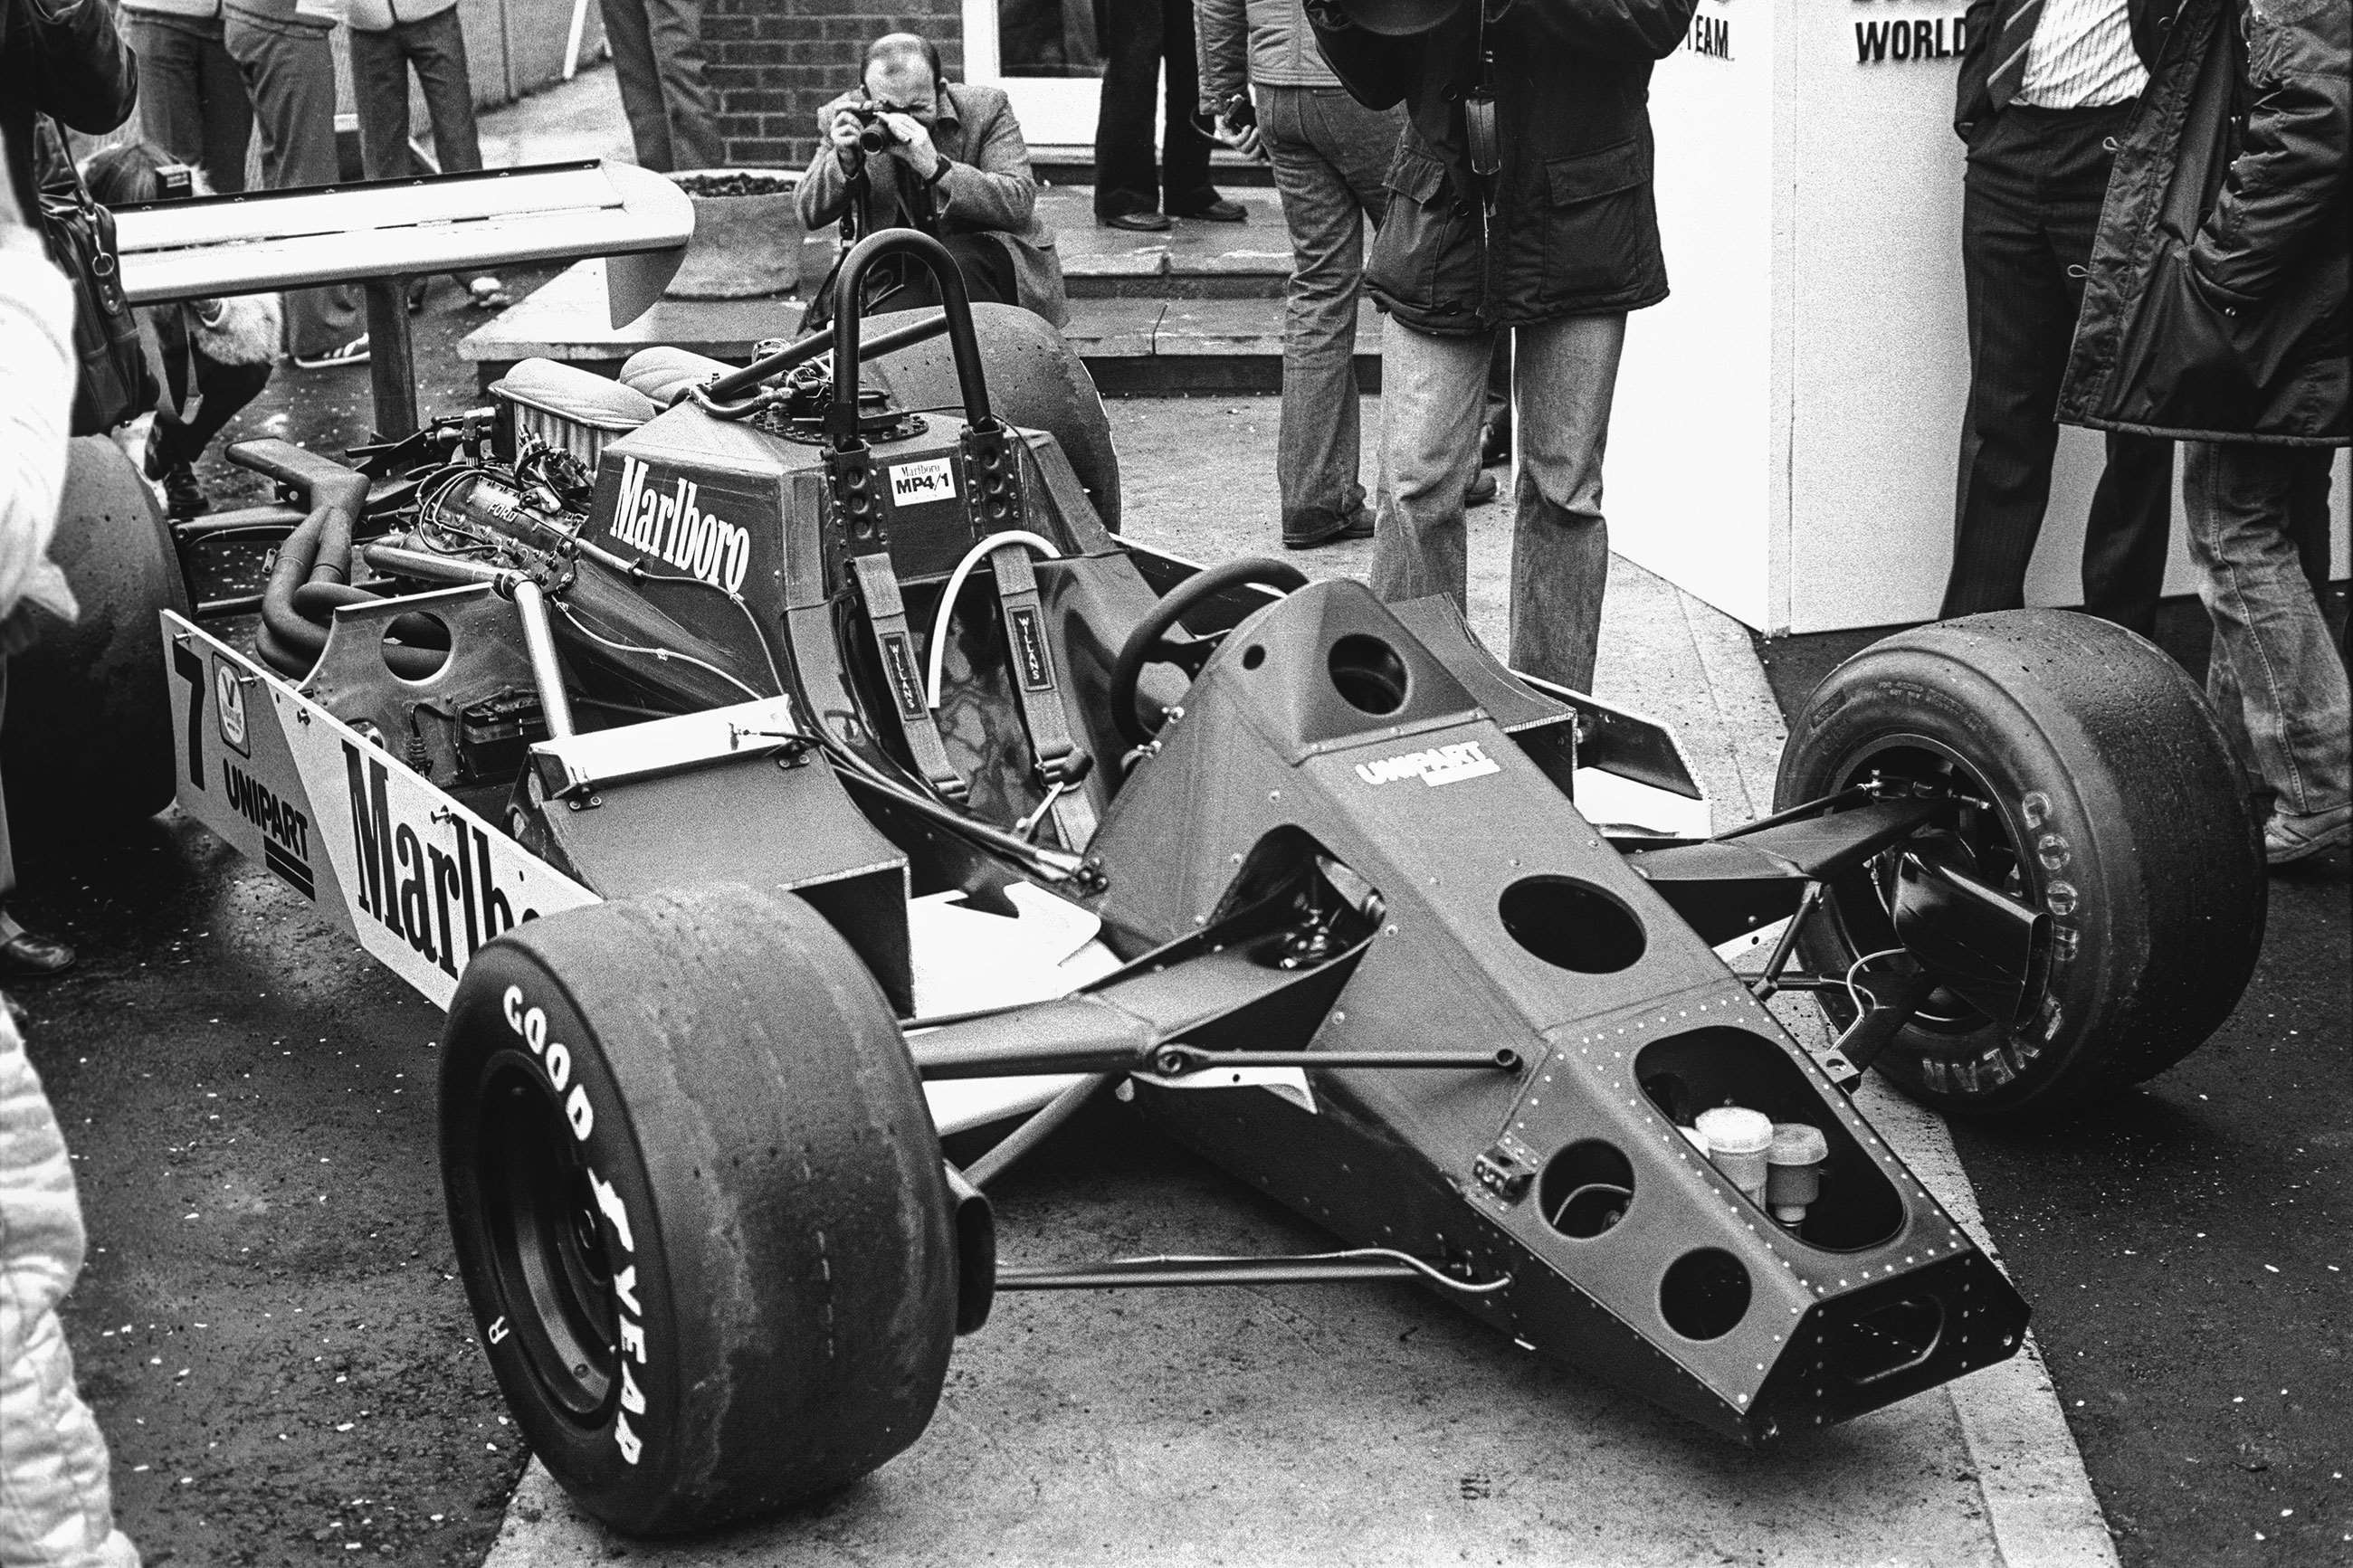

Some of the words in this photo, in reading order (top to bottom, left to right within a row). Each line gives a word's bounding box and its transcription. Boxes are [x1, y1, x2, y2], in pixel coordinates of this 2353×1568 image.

[1855, 17, 1967, 61] WORLD
[487, 500, 519, 523] FORD
[896, 472, 949, 495] MP4/1
[609, 454, 750, 594] Marlboro
[890, 644, 916, 709] WILLANS
[1018, 616, 1041, 680] WILLANS
[172, 639, 205, 792] 7
[223, 757, 309, 861] UNIPART
[341, 738, 539, 982] Marlb
[503, 984, 594, 1141] GOOD
[613, 1265, 647, 1465] YEAR
[488, 1316, 510, 1345] R
